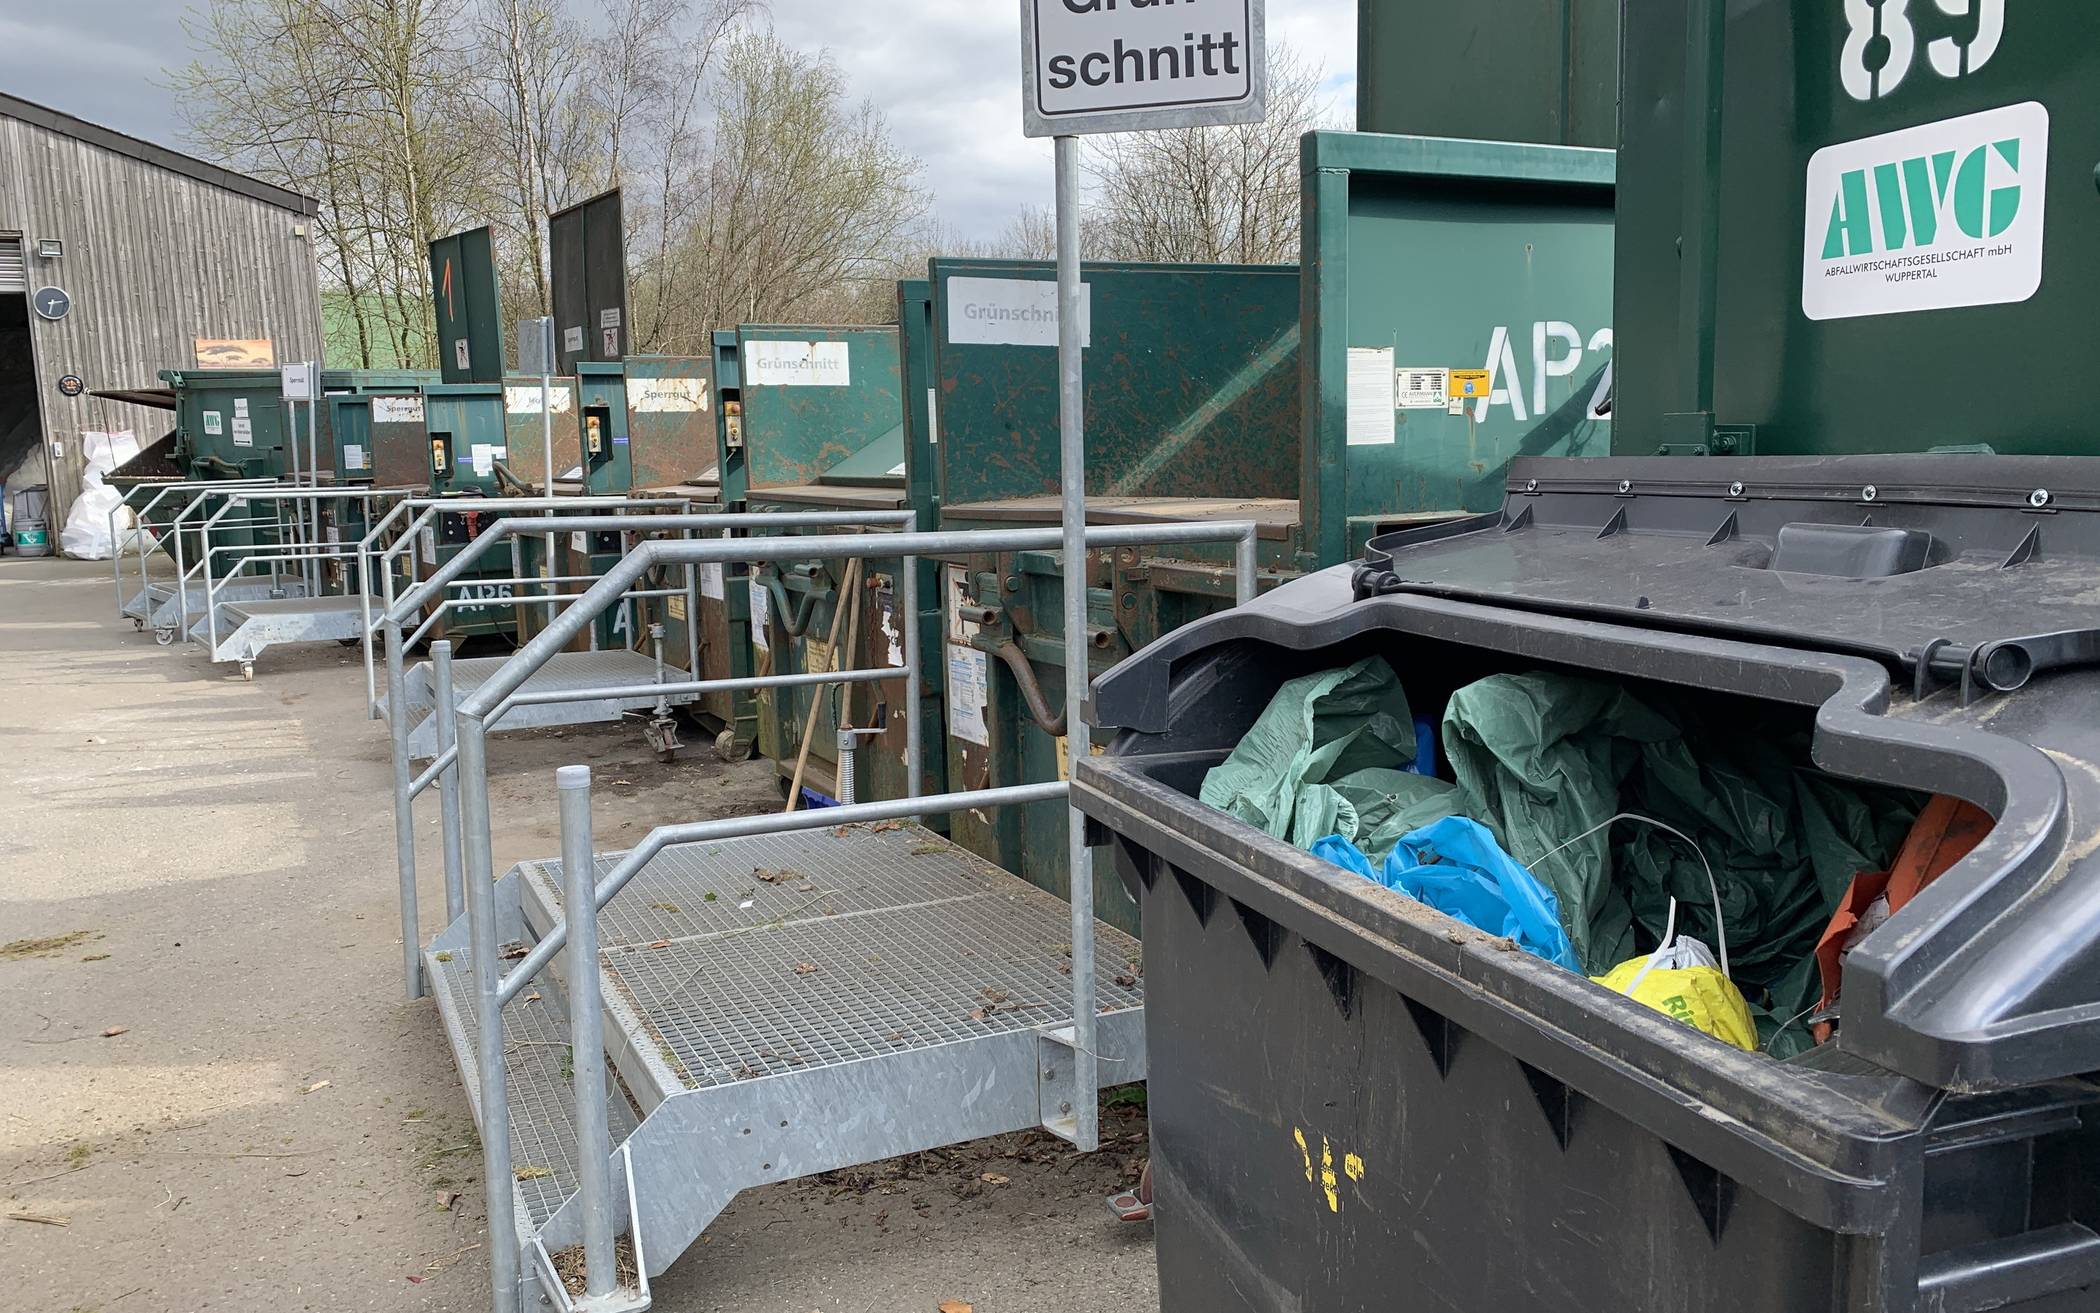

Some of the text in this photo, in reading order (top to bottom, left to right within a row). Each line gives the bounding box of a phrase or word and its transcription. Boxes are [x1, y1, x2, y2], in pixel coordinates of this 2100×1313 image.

[1048, 32, 1240, 89] schnitt
[1821, 137, 2022, 260] AWG
[1824, 243, 2013, 278] ABFALLWIRTSCHAFTSGESELLSCHAFT mbH
[1885, 268, 1938, 284] WUPPERTAL
[963, 302, 1059, 323] Grünschni
[757, 356, 841, 371] Grünschnitt
[644, 388, 692, 401] Sperrgut
[1662, 995, 1698, 1028] Ri
